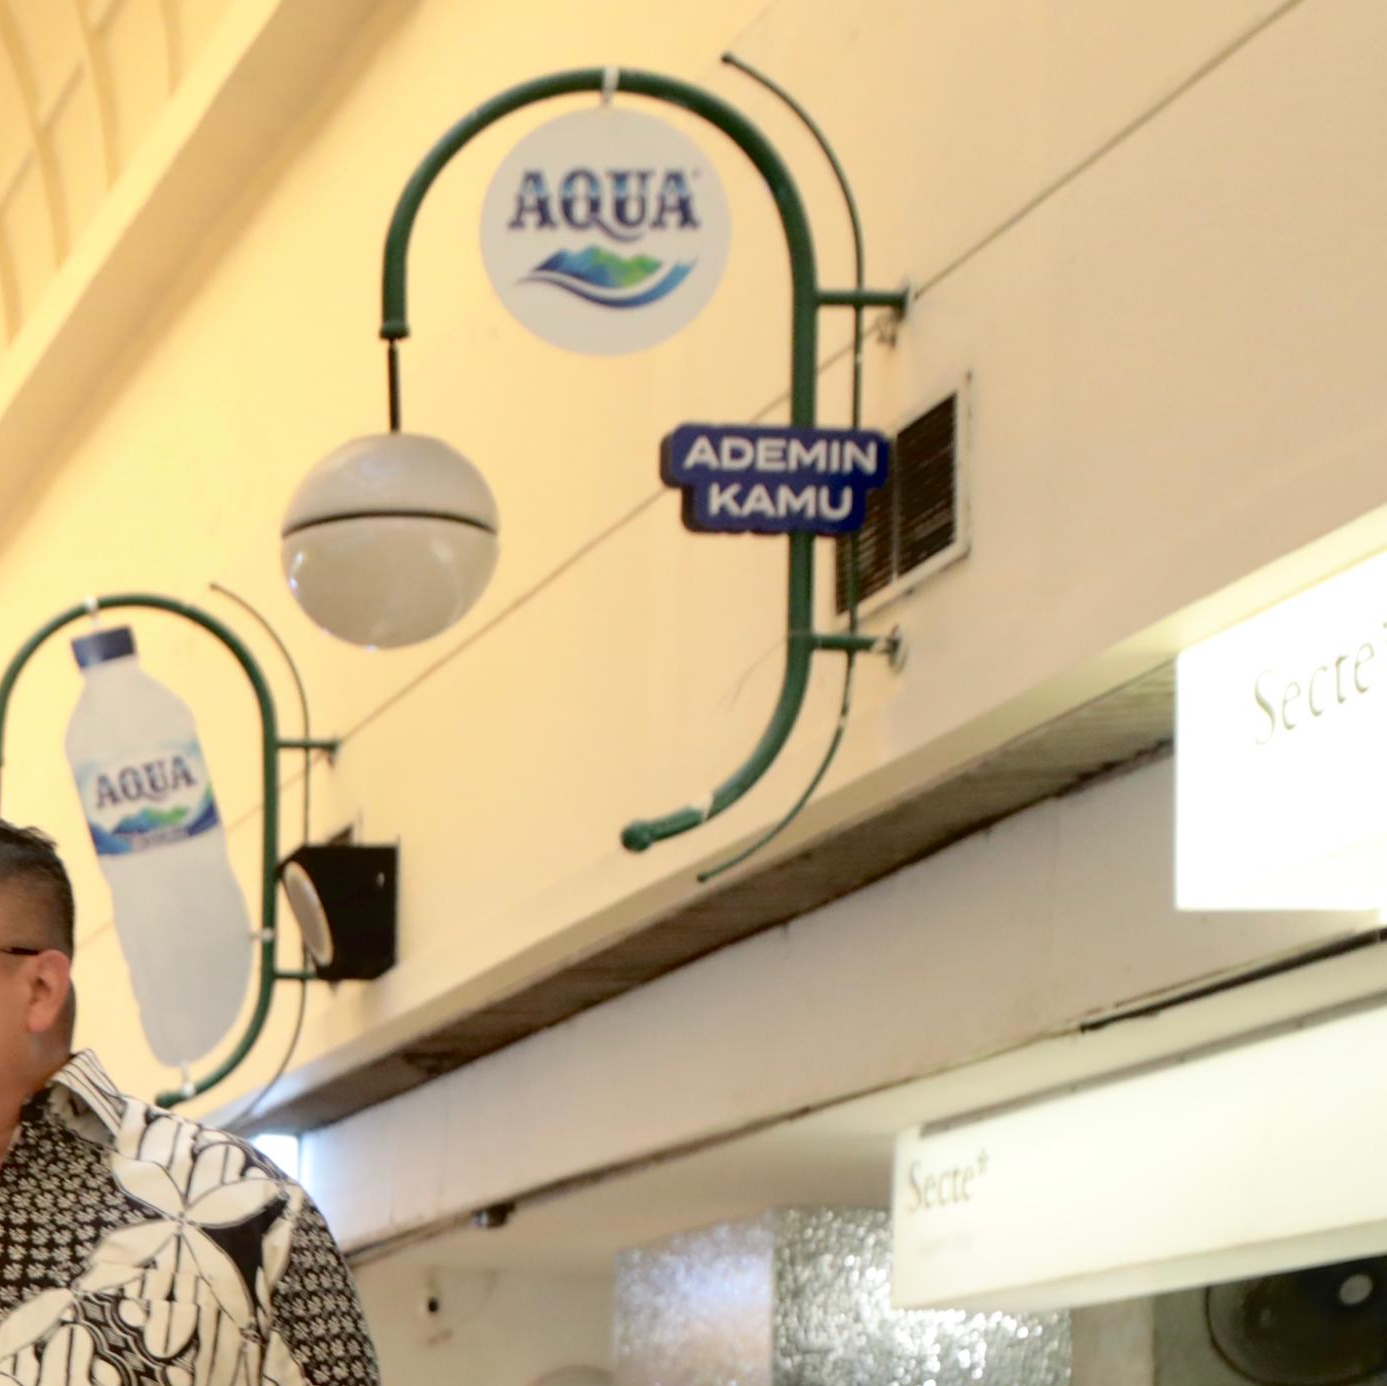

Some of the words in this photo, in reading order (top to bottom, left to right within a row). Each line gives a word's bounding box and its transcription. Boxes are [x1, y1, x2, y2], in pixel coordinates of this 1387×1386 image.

[507, 168, 702, 243] AQUA
[682, 435, 878, 475] ADEMIN
[707, 481, 854, 522] KAMU
[95, 755, 197, 810] AQUA
